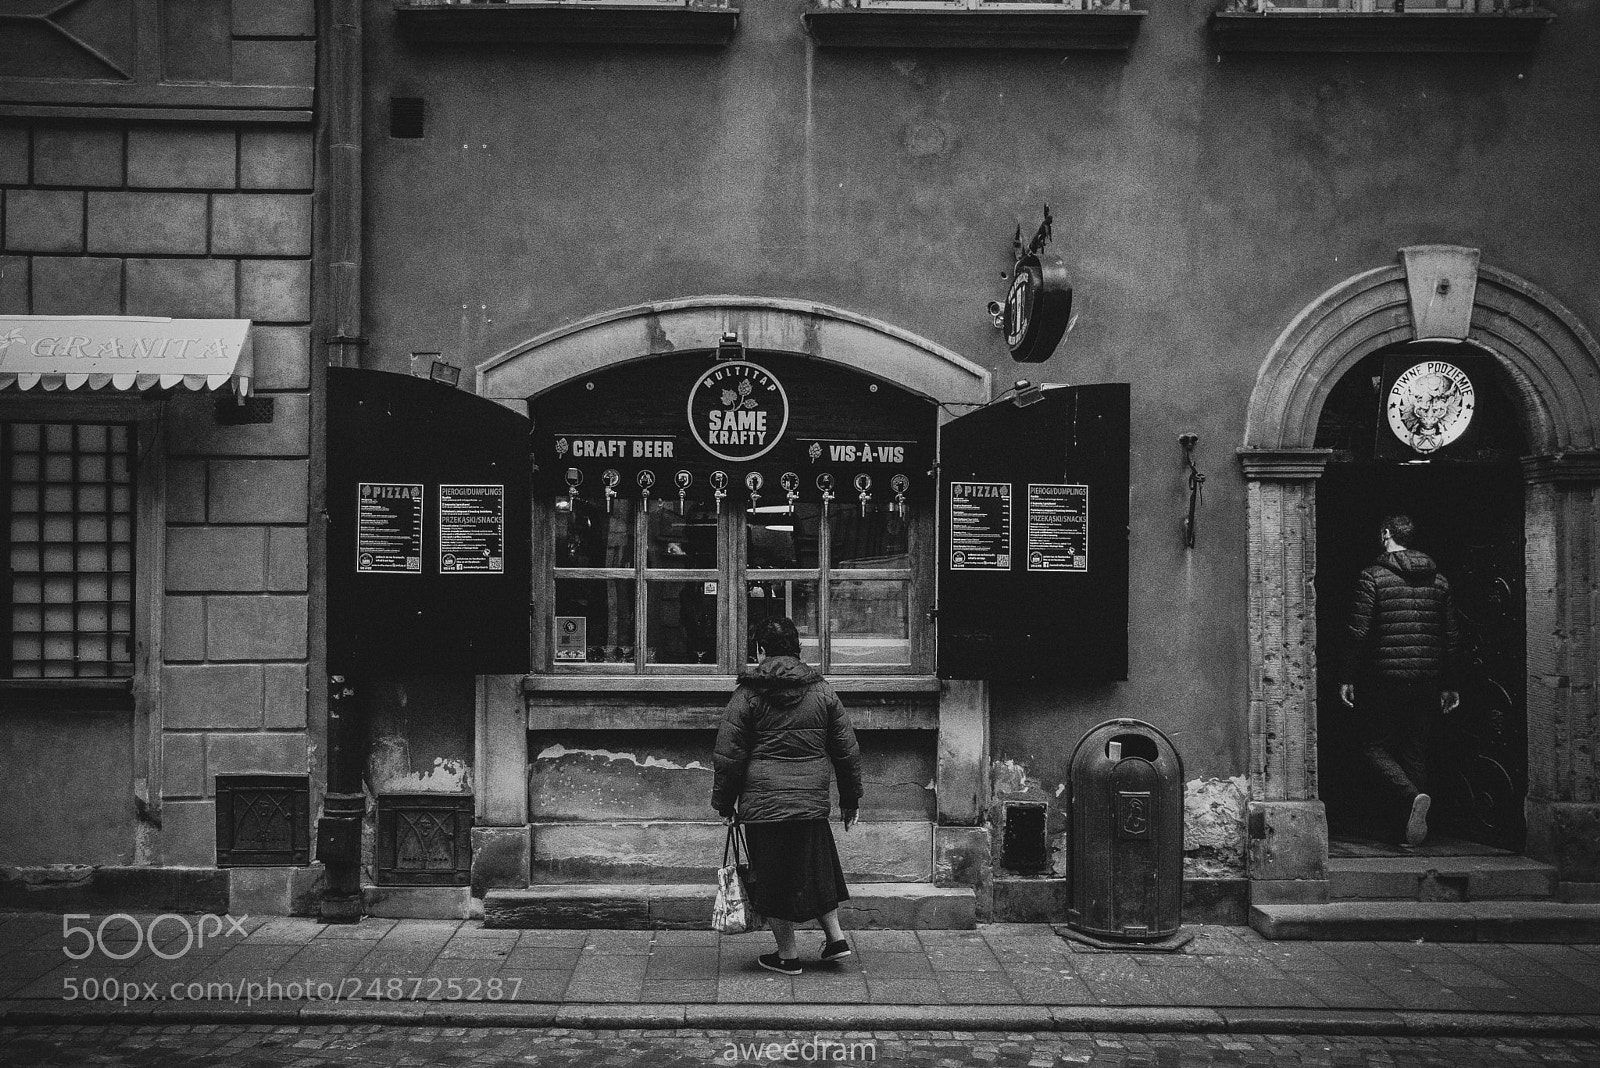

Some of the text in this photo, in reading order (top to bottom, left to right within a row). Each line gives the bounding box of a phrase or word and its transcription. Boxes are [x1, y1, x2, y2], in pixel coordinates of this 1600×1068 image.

[30, 336, 229, 359] GRANITA
[703, 366, 777, 392] MULTITAP
[1392, 362, 1473, 397] PIWNE PODZIEMIE
[709, 410, 767, 431] SAME
[709, 430, 767, 445] KRAFTY
[573, 440, 674, 458] CRAFT BEER
[829, 443, 904, 463] VIS-À-VIS
[373, 487, 410, 499] PIZZA
[964, 486, 999, 498] PIZZA
